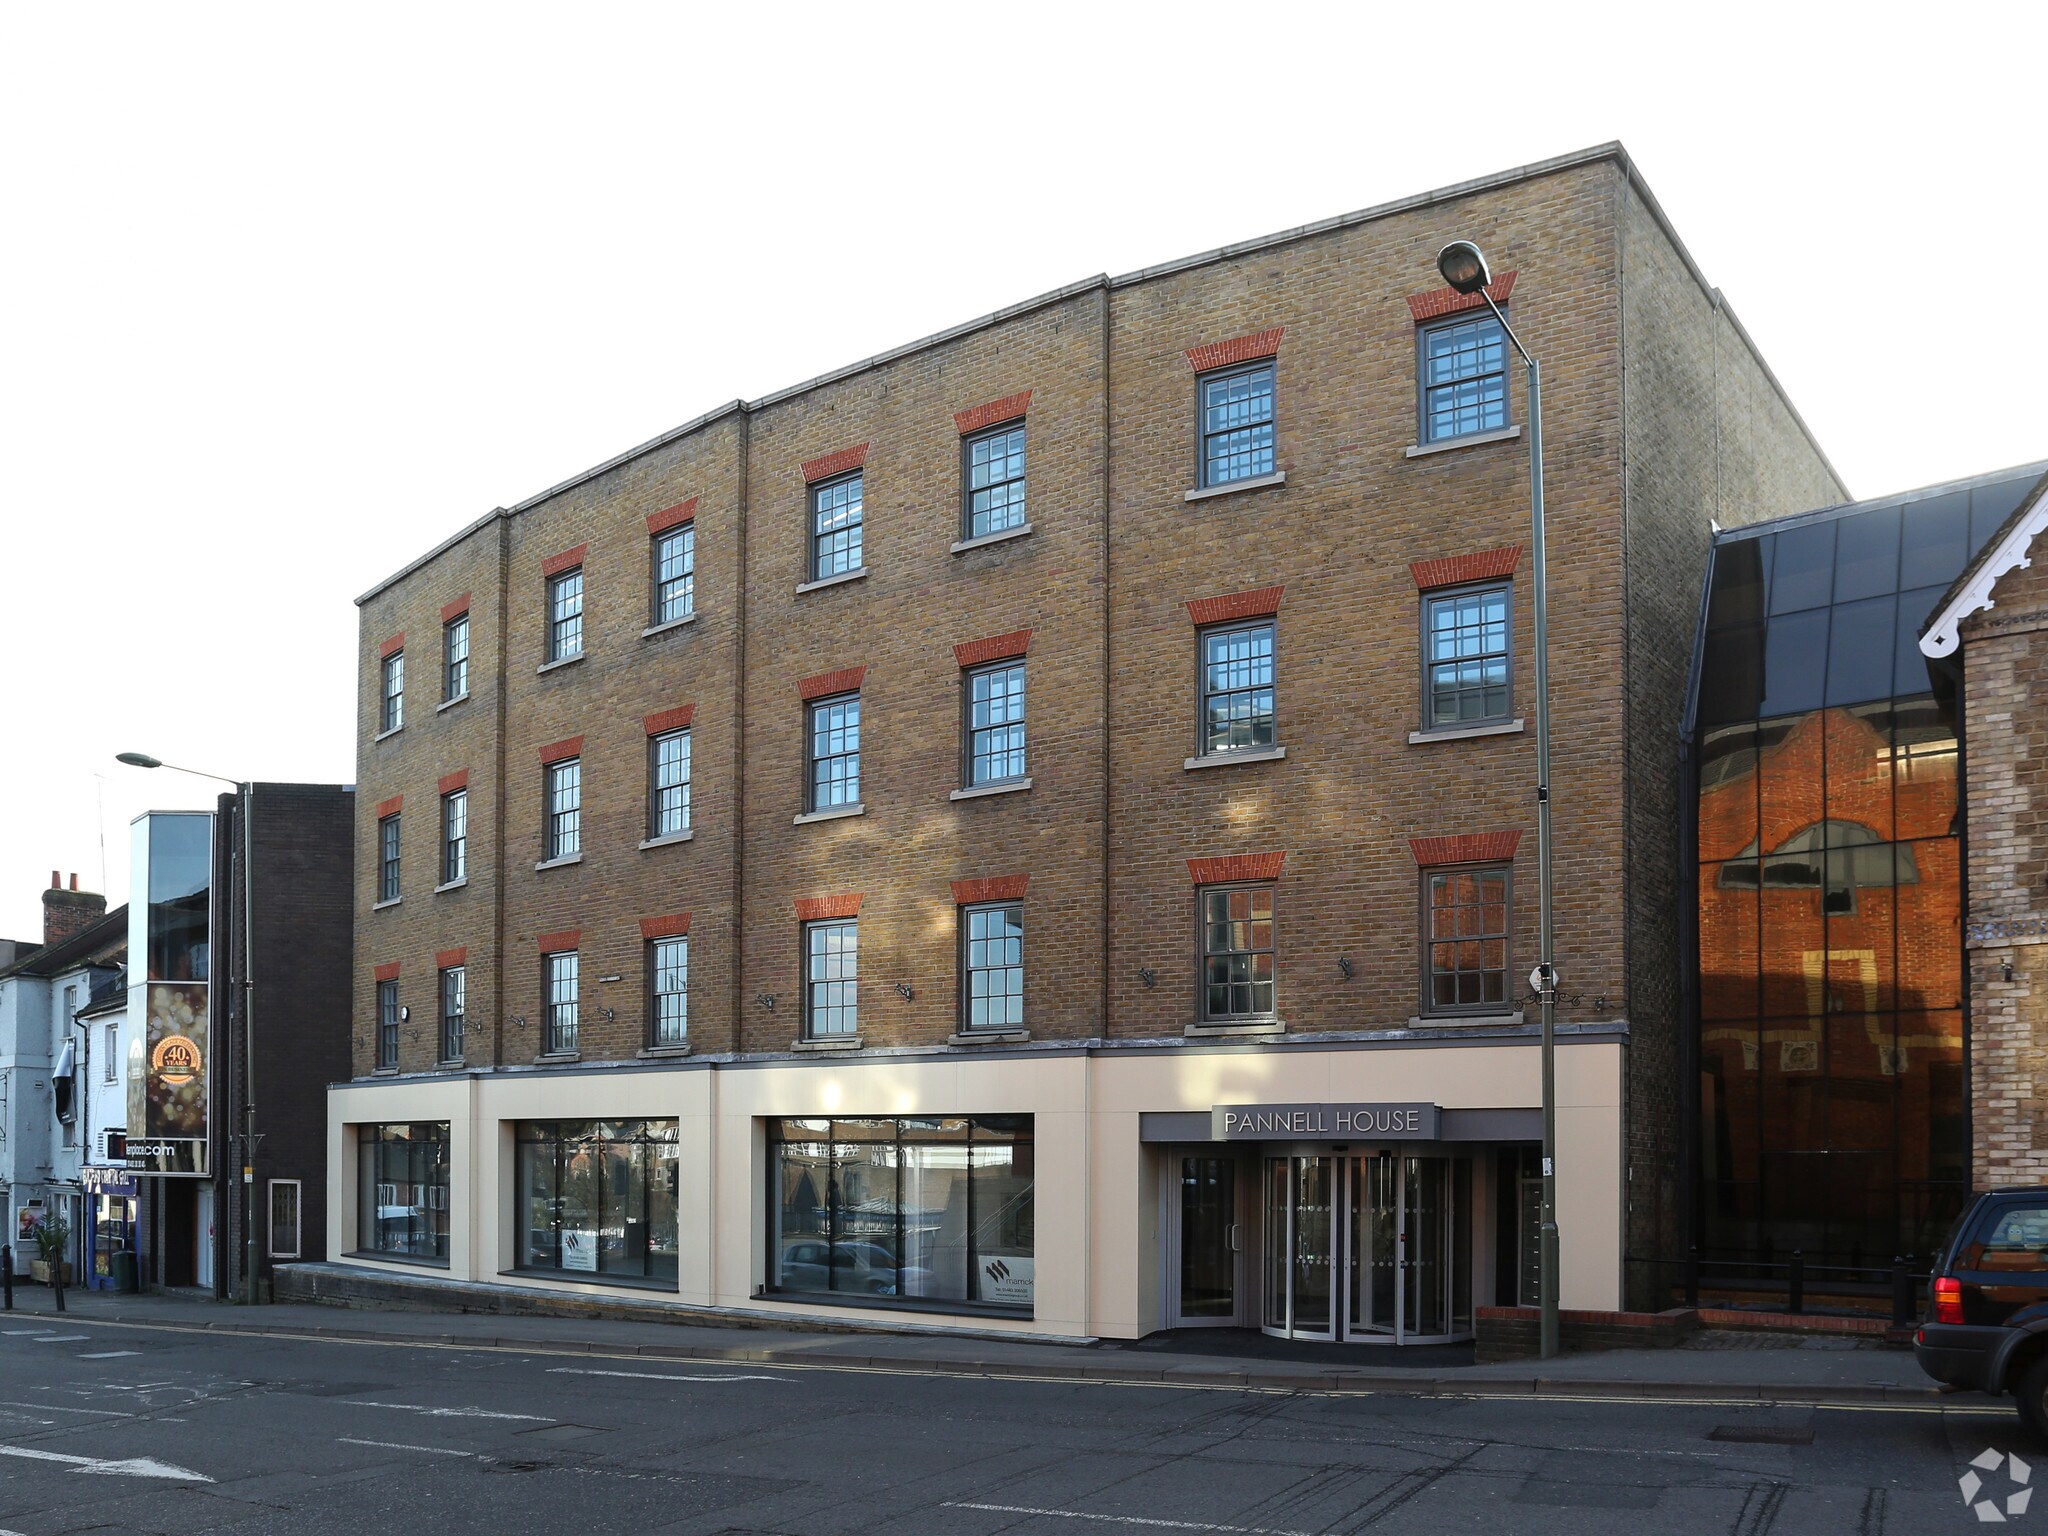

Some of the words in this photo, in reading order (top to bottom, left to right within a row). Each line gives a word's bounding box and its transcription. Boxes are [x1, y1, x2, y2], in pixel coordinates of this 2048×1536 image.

[168, 1046, 187, 1061] 40
[1224, 1111, 1328, 1133] PANNELL
[1336, 1110, 1419, 1132] HOUSE
